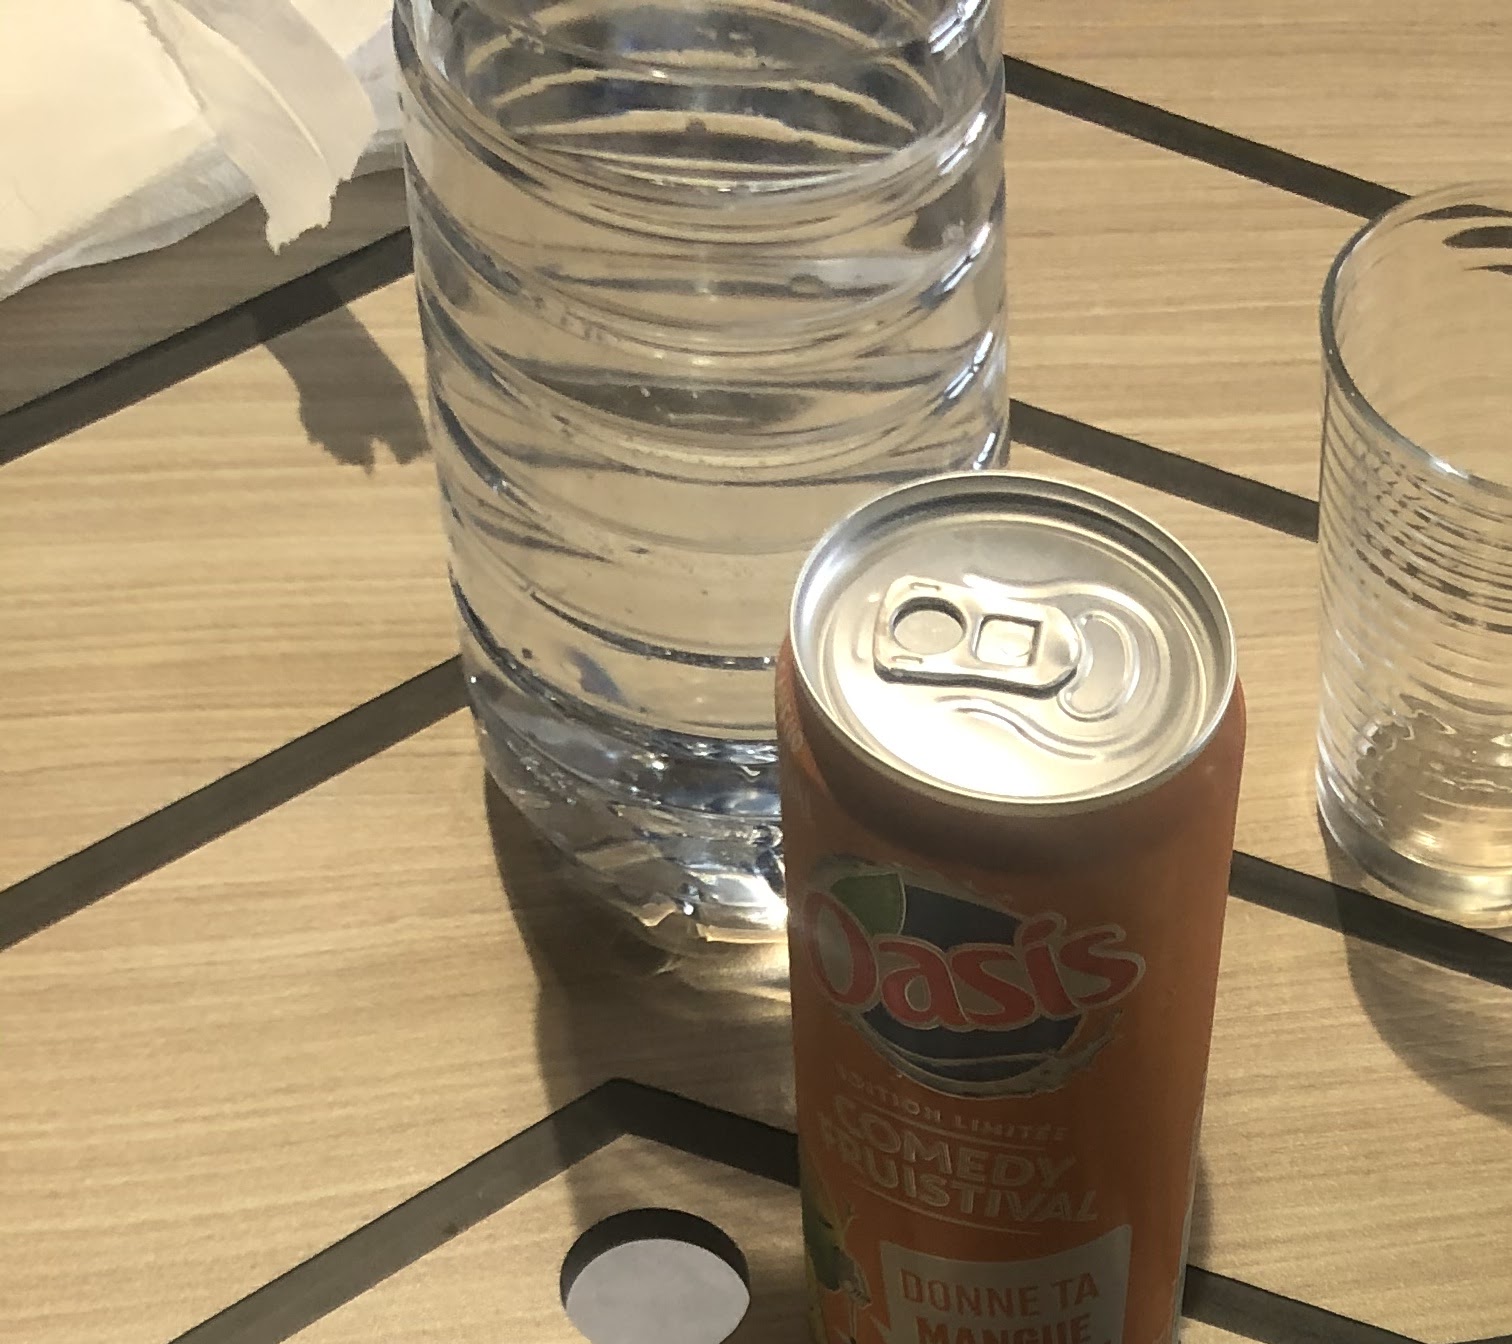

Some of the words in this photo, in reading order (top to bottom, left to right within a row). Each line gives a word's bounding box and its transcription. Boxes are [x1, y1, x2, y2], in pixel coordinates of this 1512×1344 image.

[805, 890, 1146, 1031] Oasis
[835, 1095, 1077, 1189] COMEDY
[901, 1268, 1040, 1318] DONNE
[1051, 1272, 1099, 1311] TA
